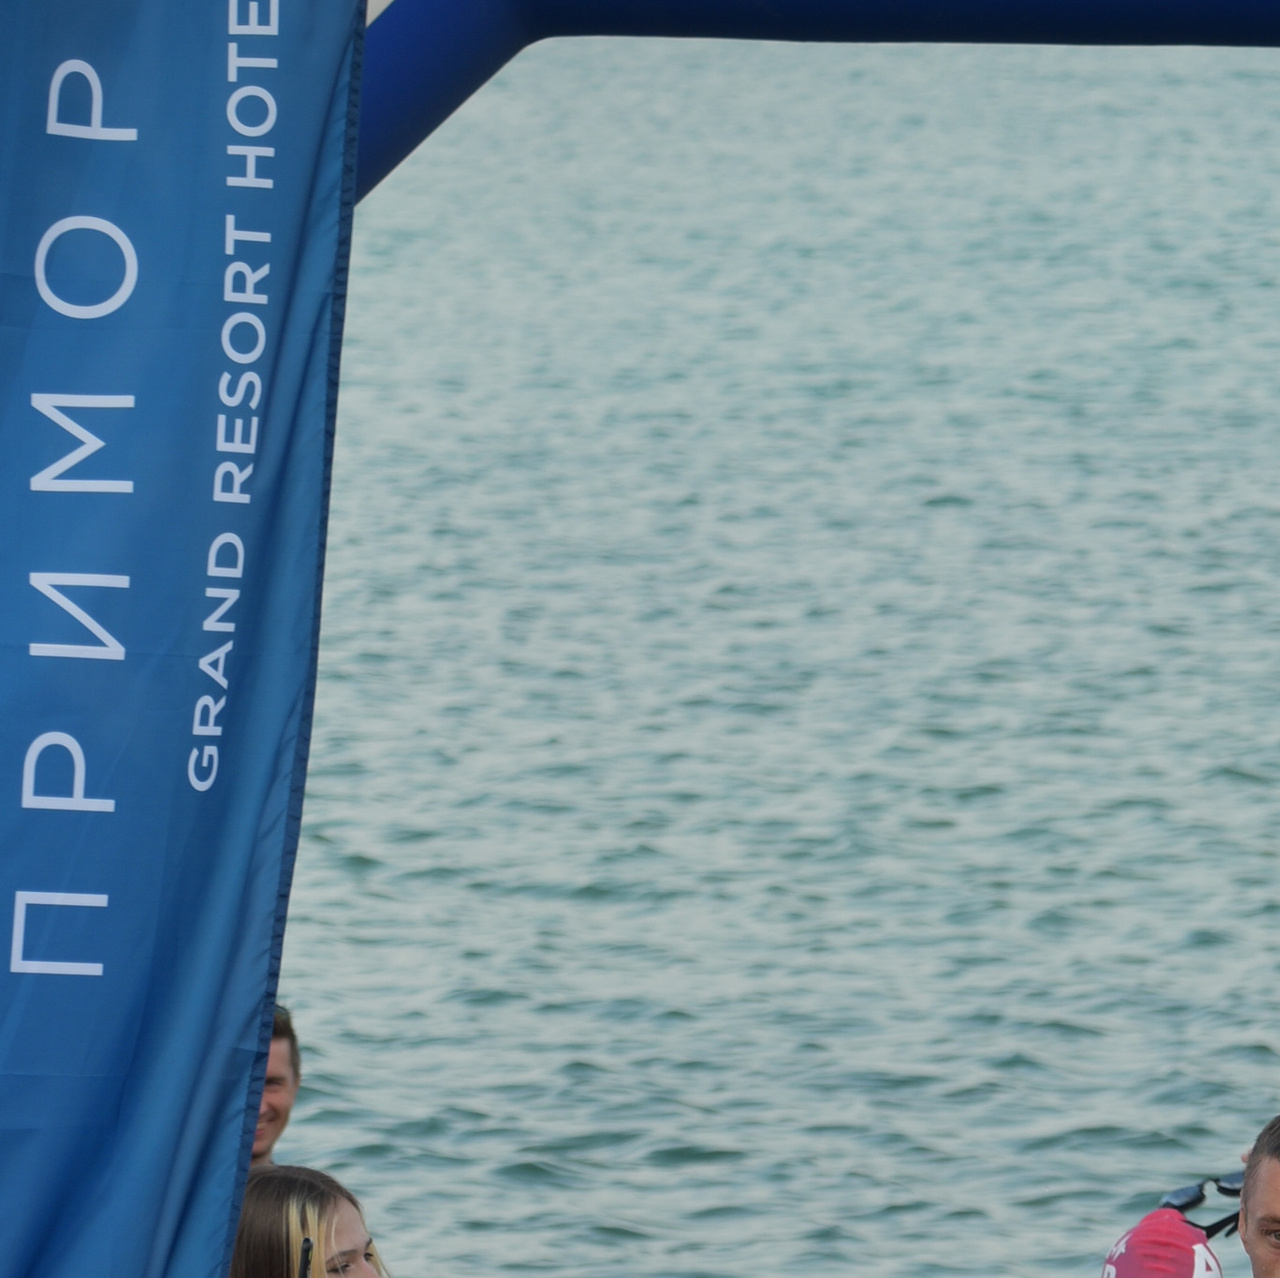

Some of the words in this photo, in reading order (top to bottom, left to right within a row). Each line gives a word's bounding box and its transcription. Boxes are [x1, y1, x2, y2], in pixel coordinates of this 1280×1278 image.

[225, 0, 279, 189] HOTE
[213, 214, 272, 505] RESORT
[9, 59, 139, 977] ПРИМОР
[187, 530, 246, 792] GRAND
